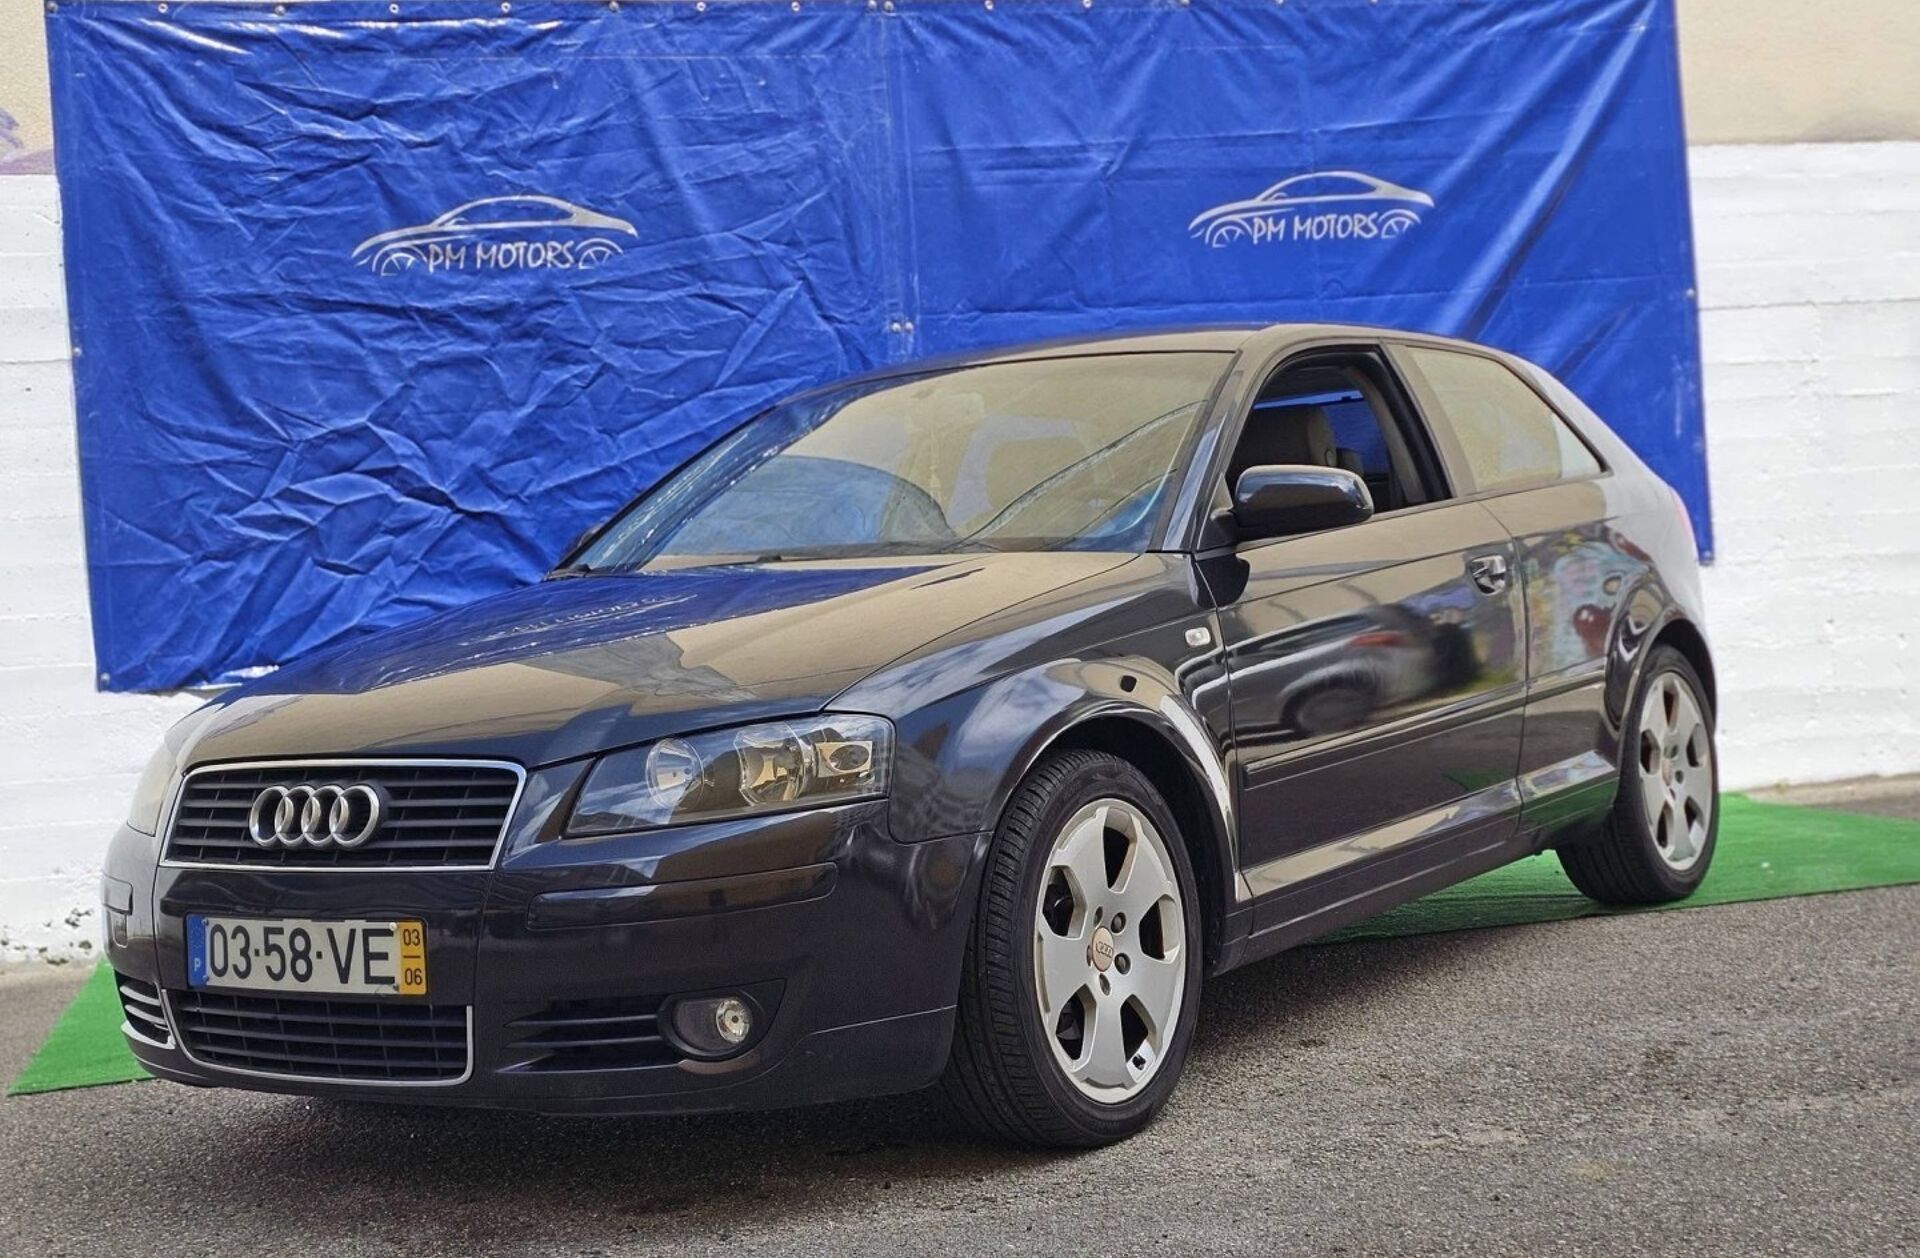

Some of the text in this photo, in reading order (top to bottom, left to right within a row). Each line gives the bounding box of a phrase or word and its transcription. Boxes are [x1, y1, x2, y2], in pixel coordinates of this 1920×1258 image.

[1253, 211, 1379, 245] PM MOTORS
[428, 240, 575, 273] PM MOTORS
[403, 929, 421, 946] 03
[194, 957, 201, 972] P
[404, 968, 423, 985] 06
